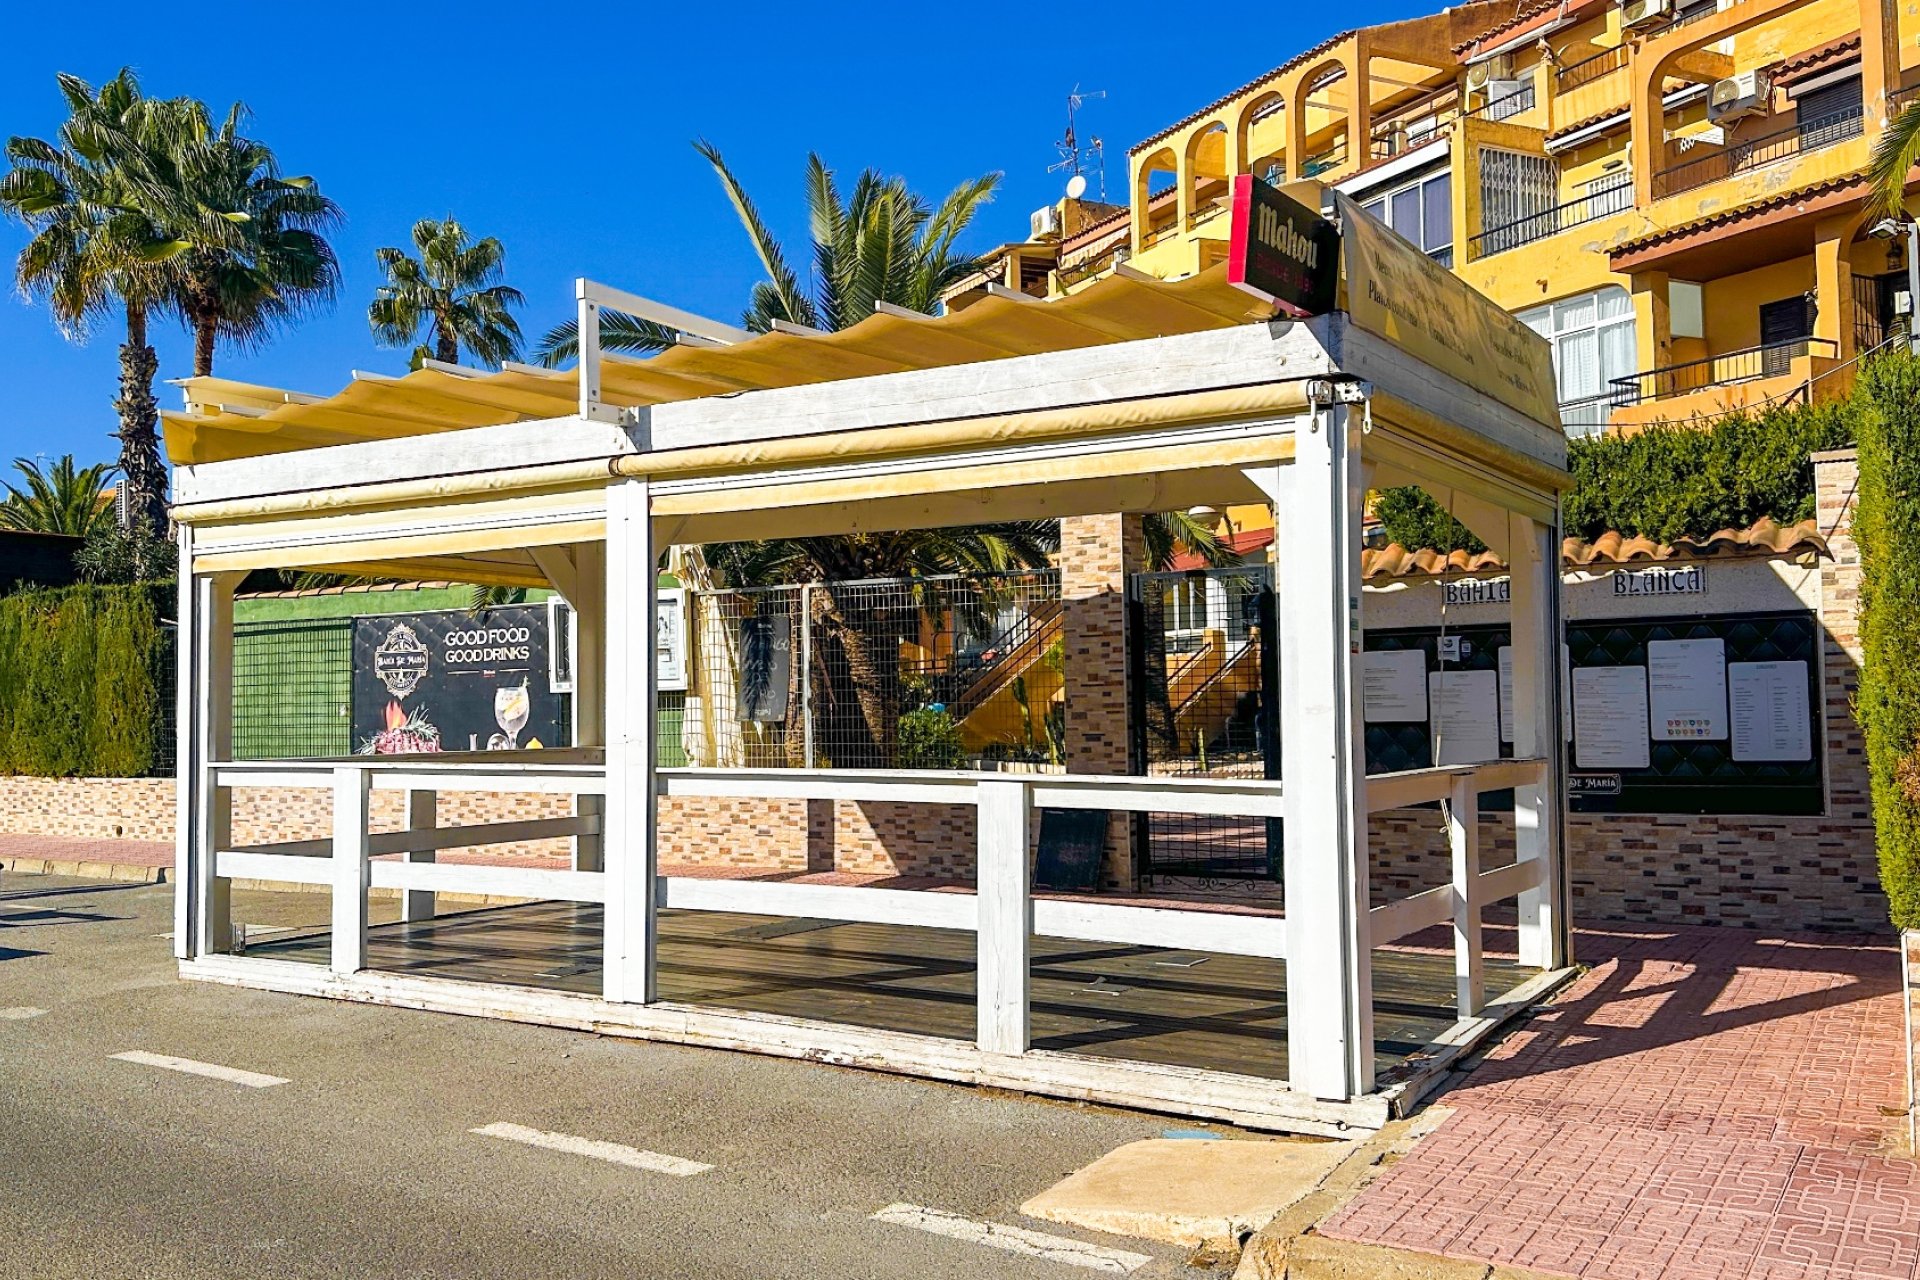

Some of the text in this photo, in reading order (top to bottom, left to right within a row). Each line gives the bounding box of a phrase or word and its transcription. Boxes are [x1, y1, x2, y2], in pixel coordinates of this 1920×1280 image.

[1258, 202, 1318, 269] Mahou
[1614, 570, 1700, 594] BLANCA
[445, 627, 530, 646] GOOD FOOD
[445, 645, 530, 663] GOOD DRINKS
